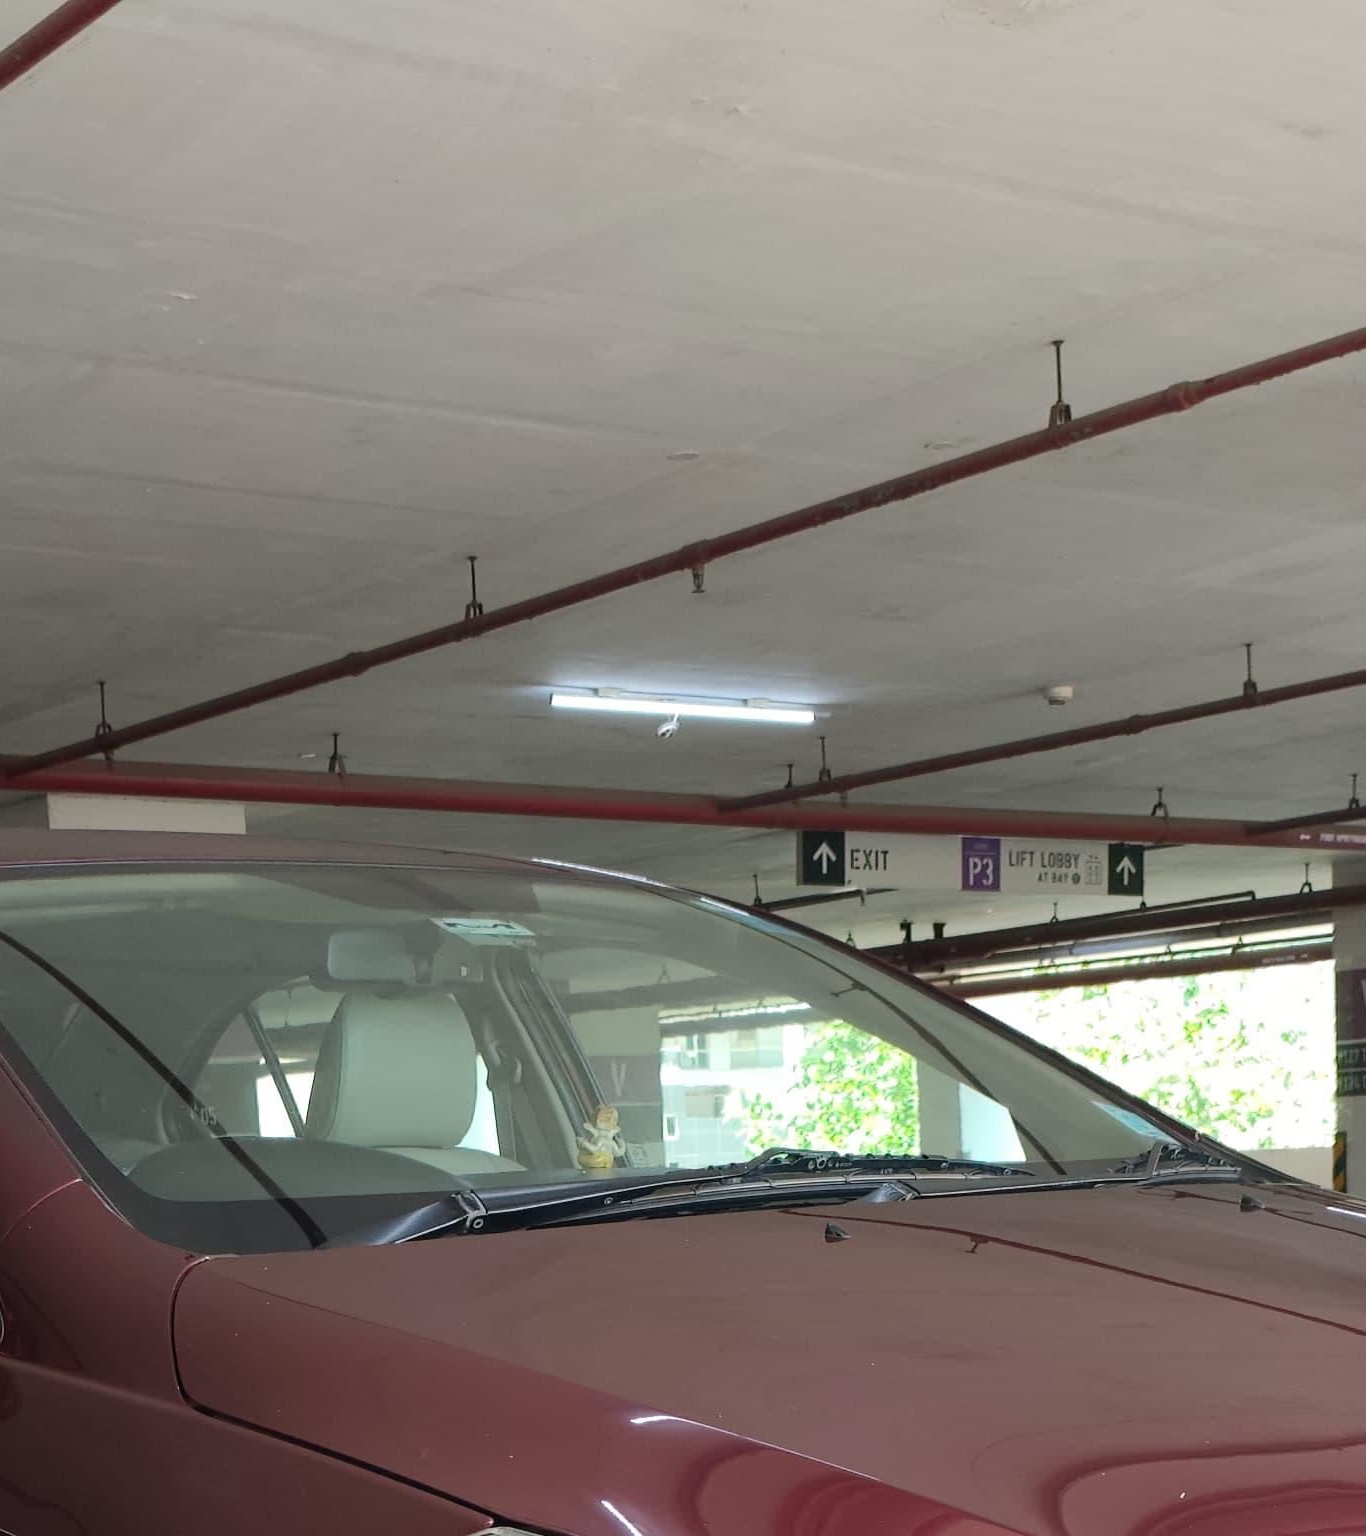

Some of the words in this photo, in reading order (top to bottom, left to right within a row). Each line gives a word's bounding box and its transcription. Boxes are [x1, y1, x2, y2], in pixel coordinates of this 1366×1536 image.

[850, 849, 889, 871] EXIT
[1008, 850, 1035, 867] LIFT
[1040, 851, 1081, 869] LOBBY
[968, 856, 994, 886] P3
